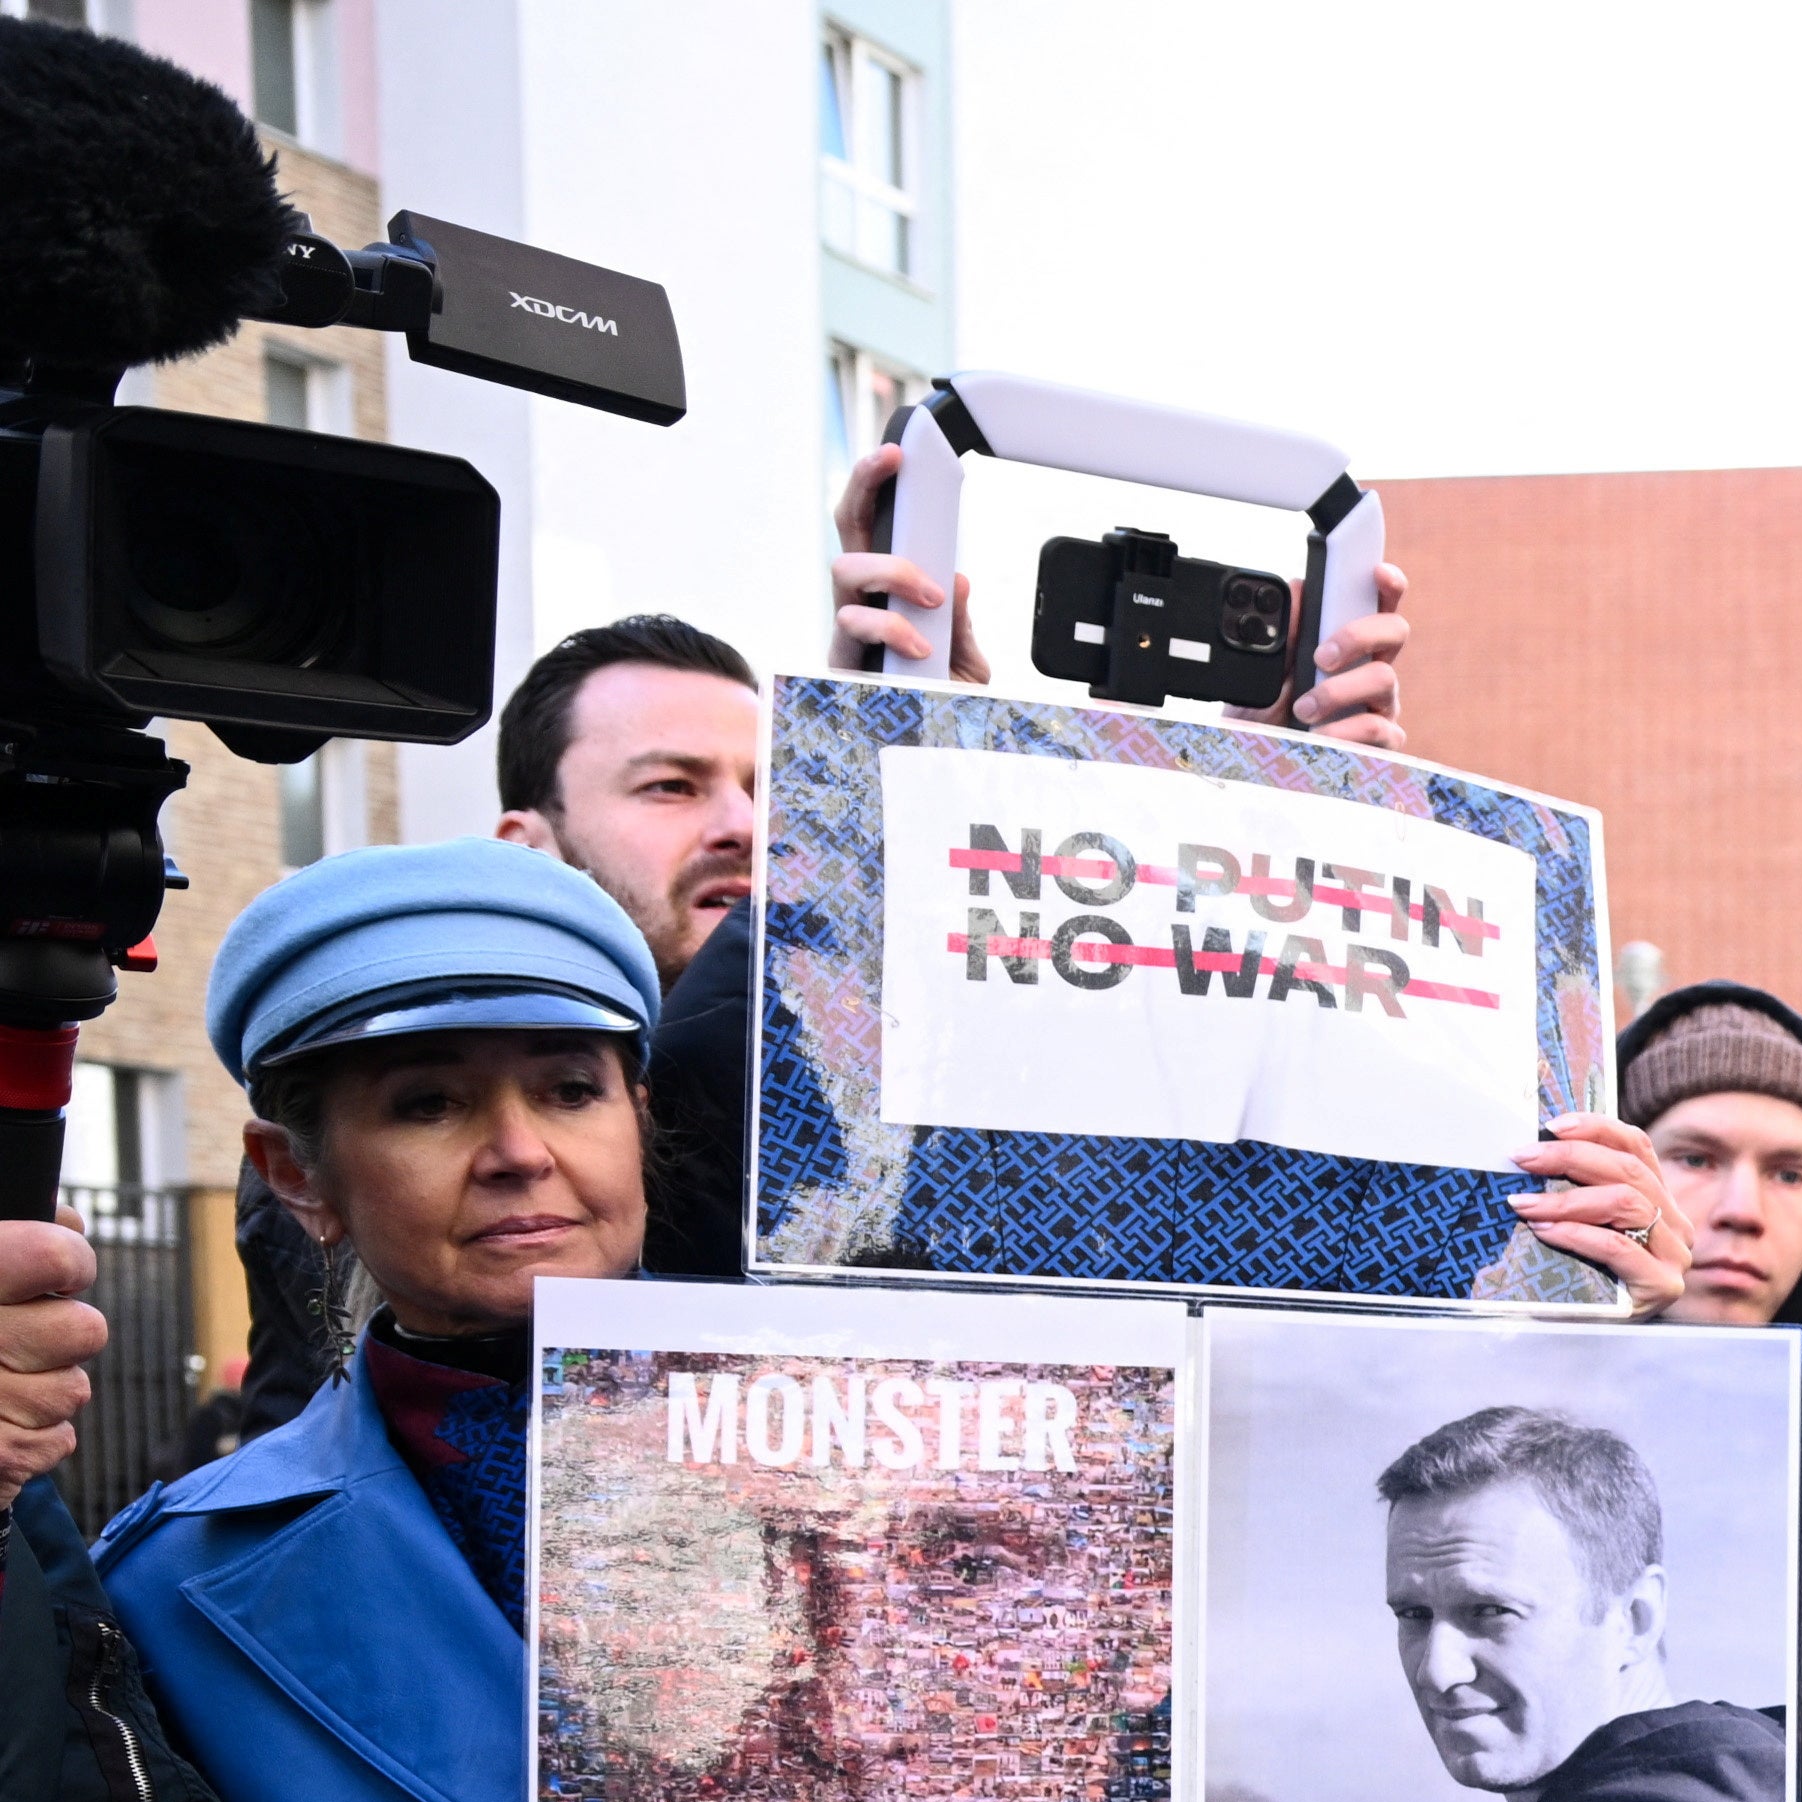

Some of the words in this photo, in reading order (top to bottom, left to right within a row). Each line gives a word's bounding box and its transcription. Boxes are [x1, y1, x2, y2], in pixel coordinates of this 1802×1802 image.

[508, 291, 619, 336] XDCAM
[967, 823, 1136, 907] NO
[1175, 842, 1485, 958] PUTIN
[965, 907, 1135, 990] NO
[1171, 923, 1410, 1019] WAR
[667, 1371, 1078, 1472] MONSTER
